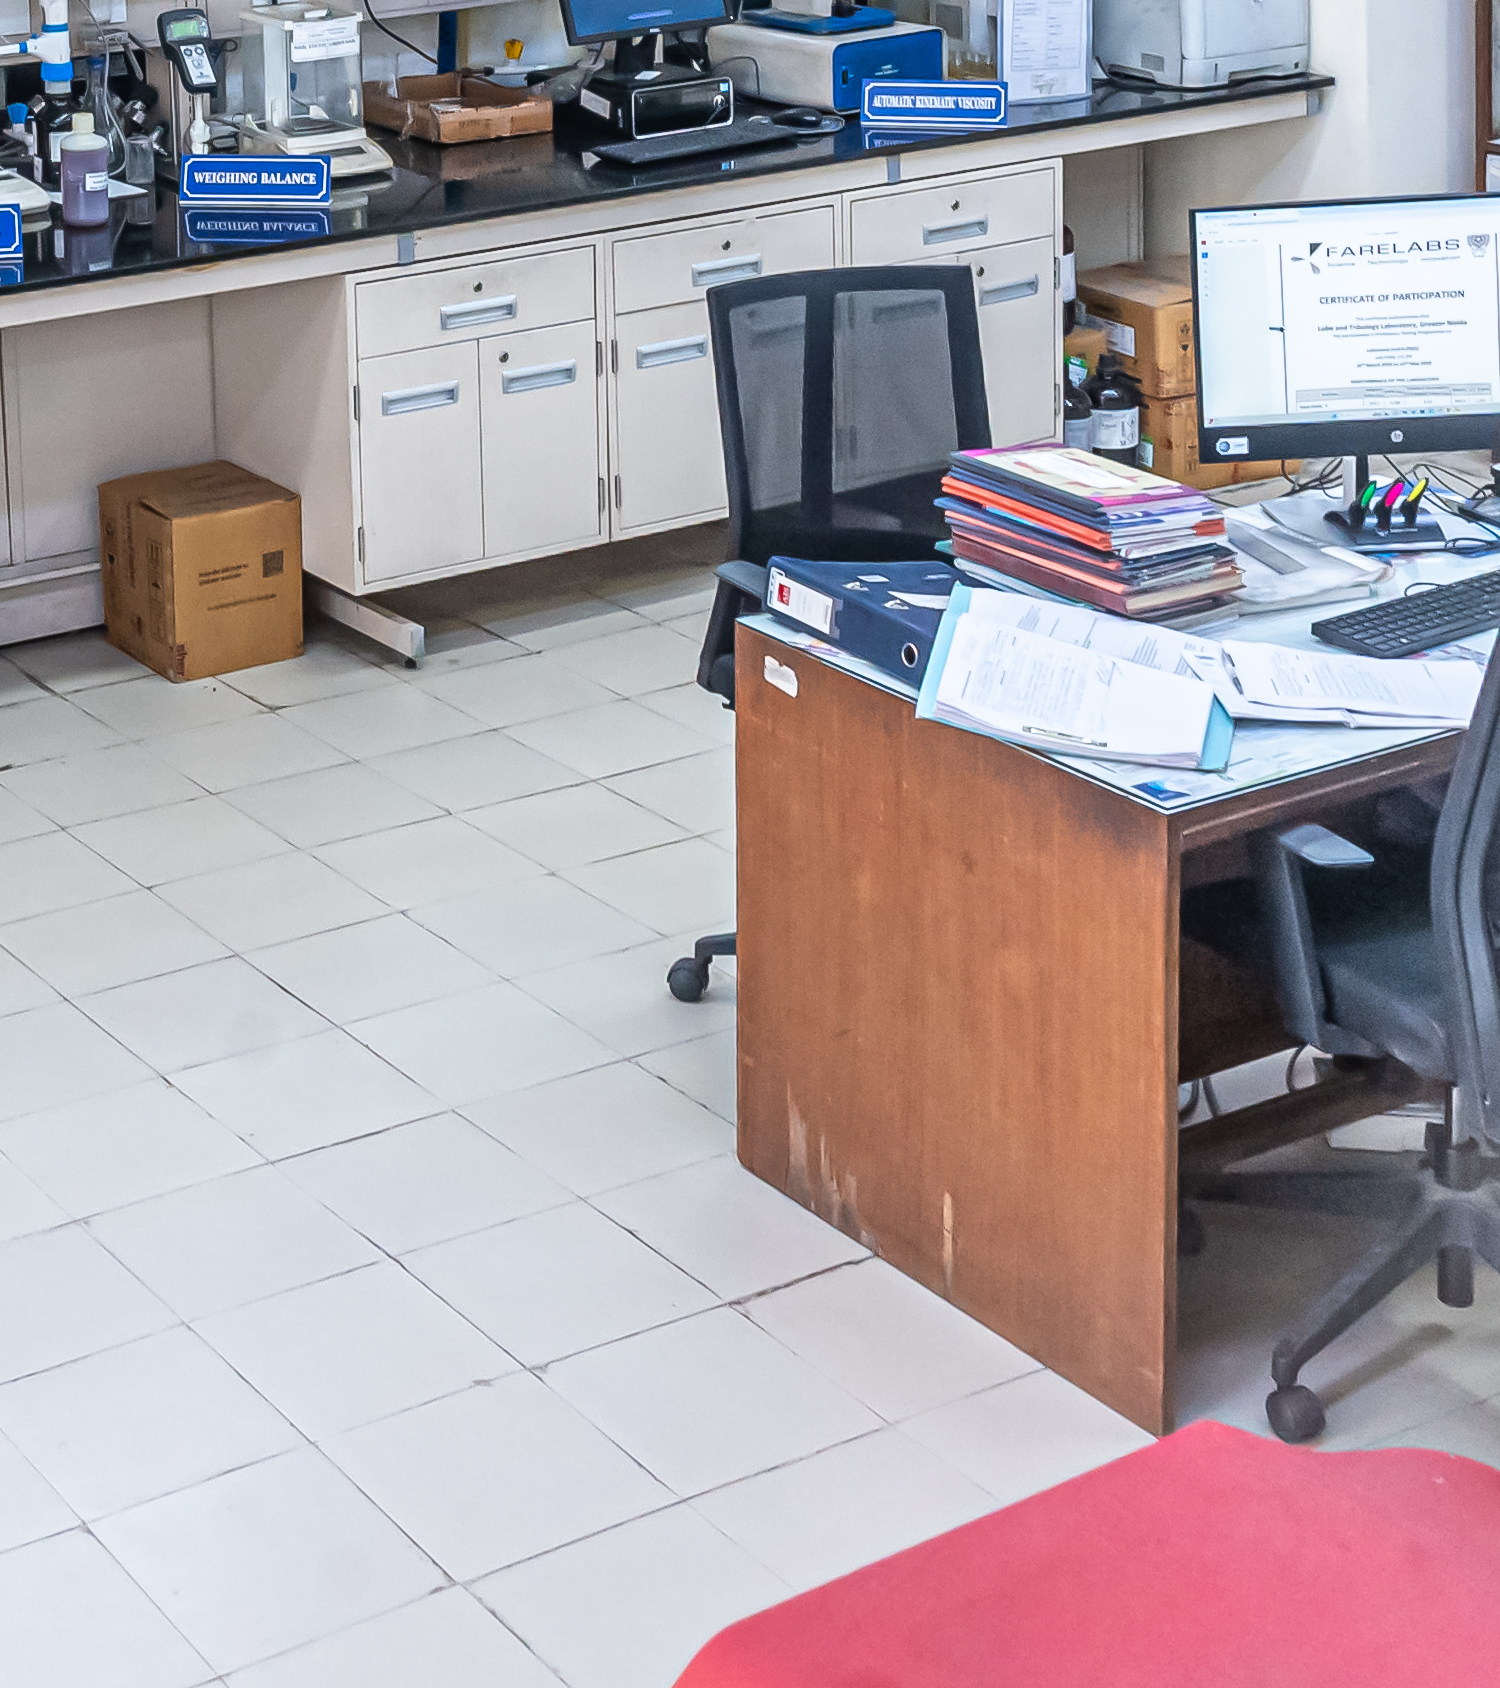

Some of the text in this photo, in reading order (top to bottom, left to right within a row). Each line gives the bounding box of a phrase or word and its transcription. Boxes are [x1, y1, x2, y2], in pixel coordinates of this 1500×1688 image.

[872, 95, 997, 110] AUTOMATIC KINEMATIC VISCOSITY
[194, 171, 317, 185] WEIGHING BALANCE
[1325, 238, 1461, 258] FARELABS
[1319, 289, 1465, 305] CERTIFICATE OF PARTICIPATION
